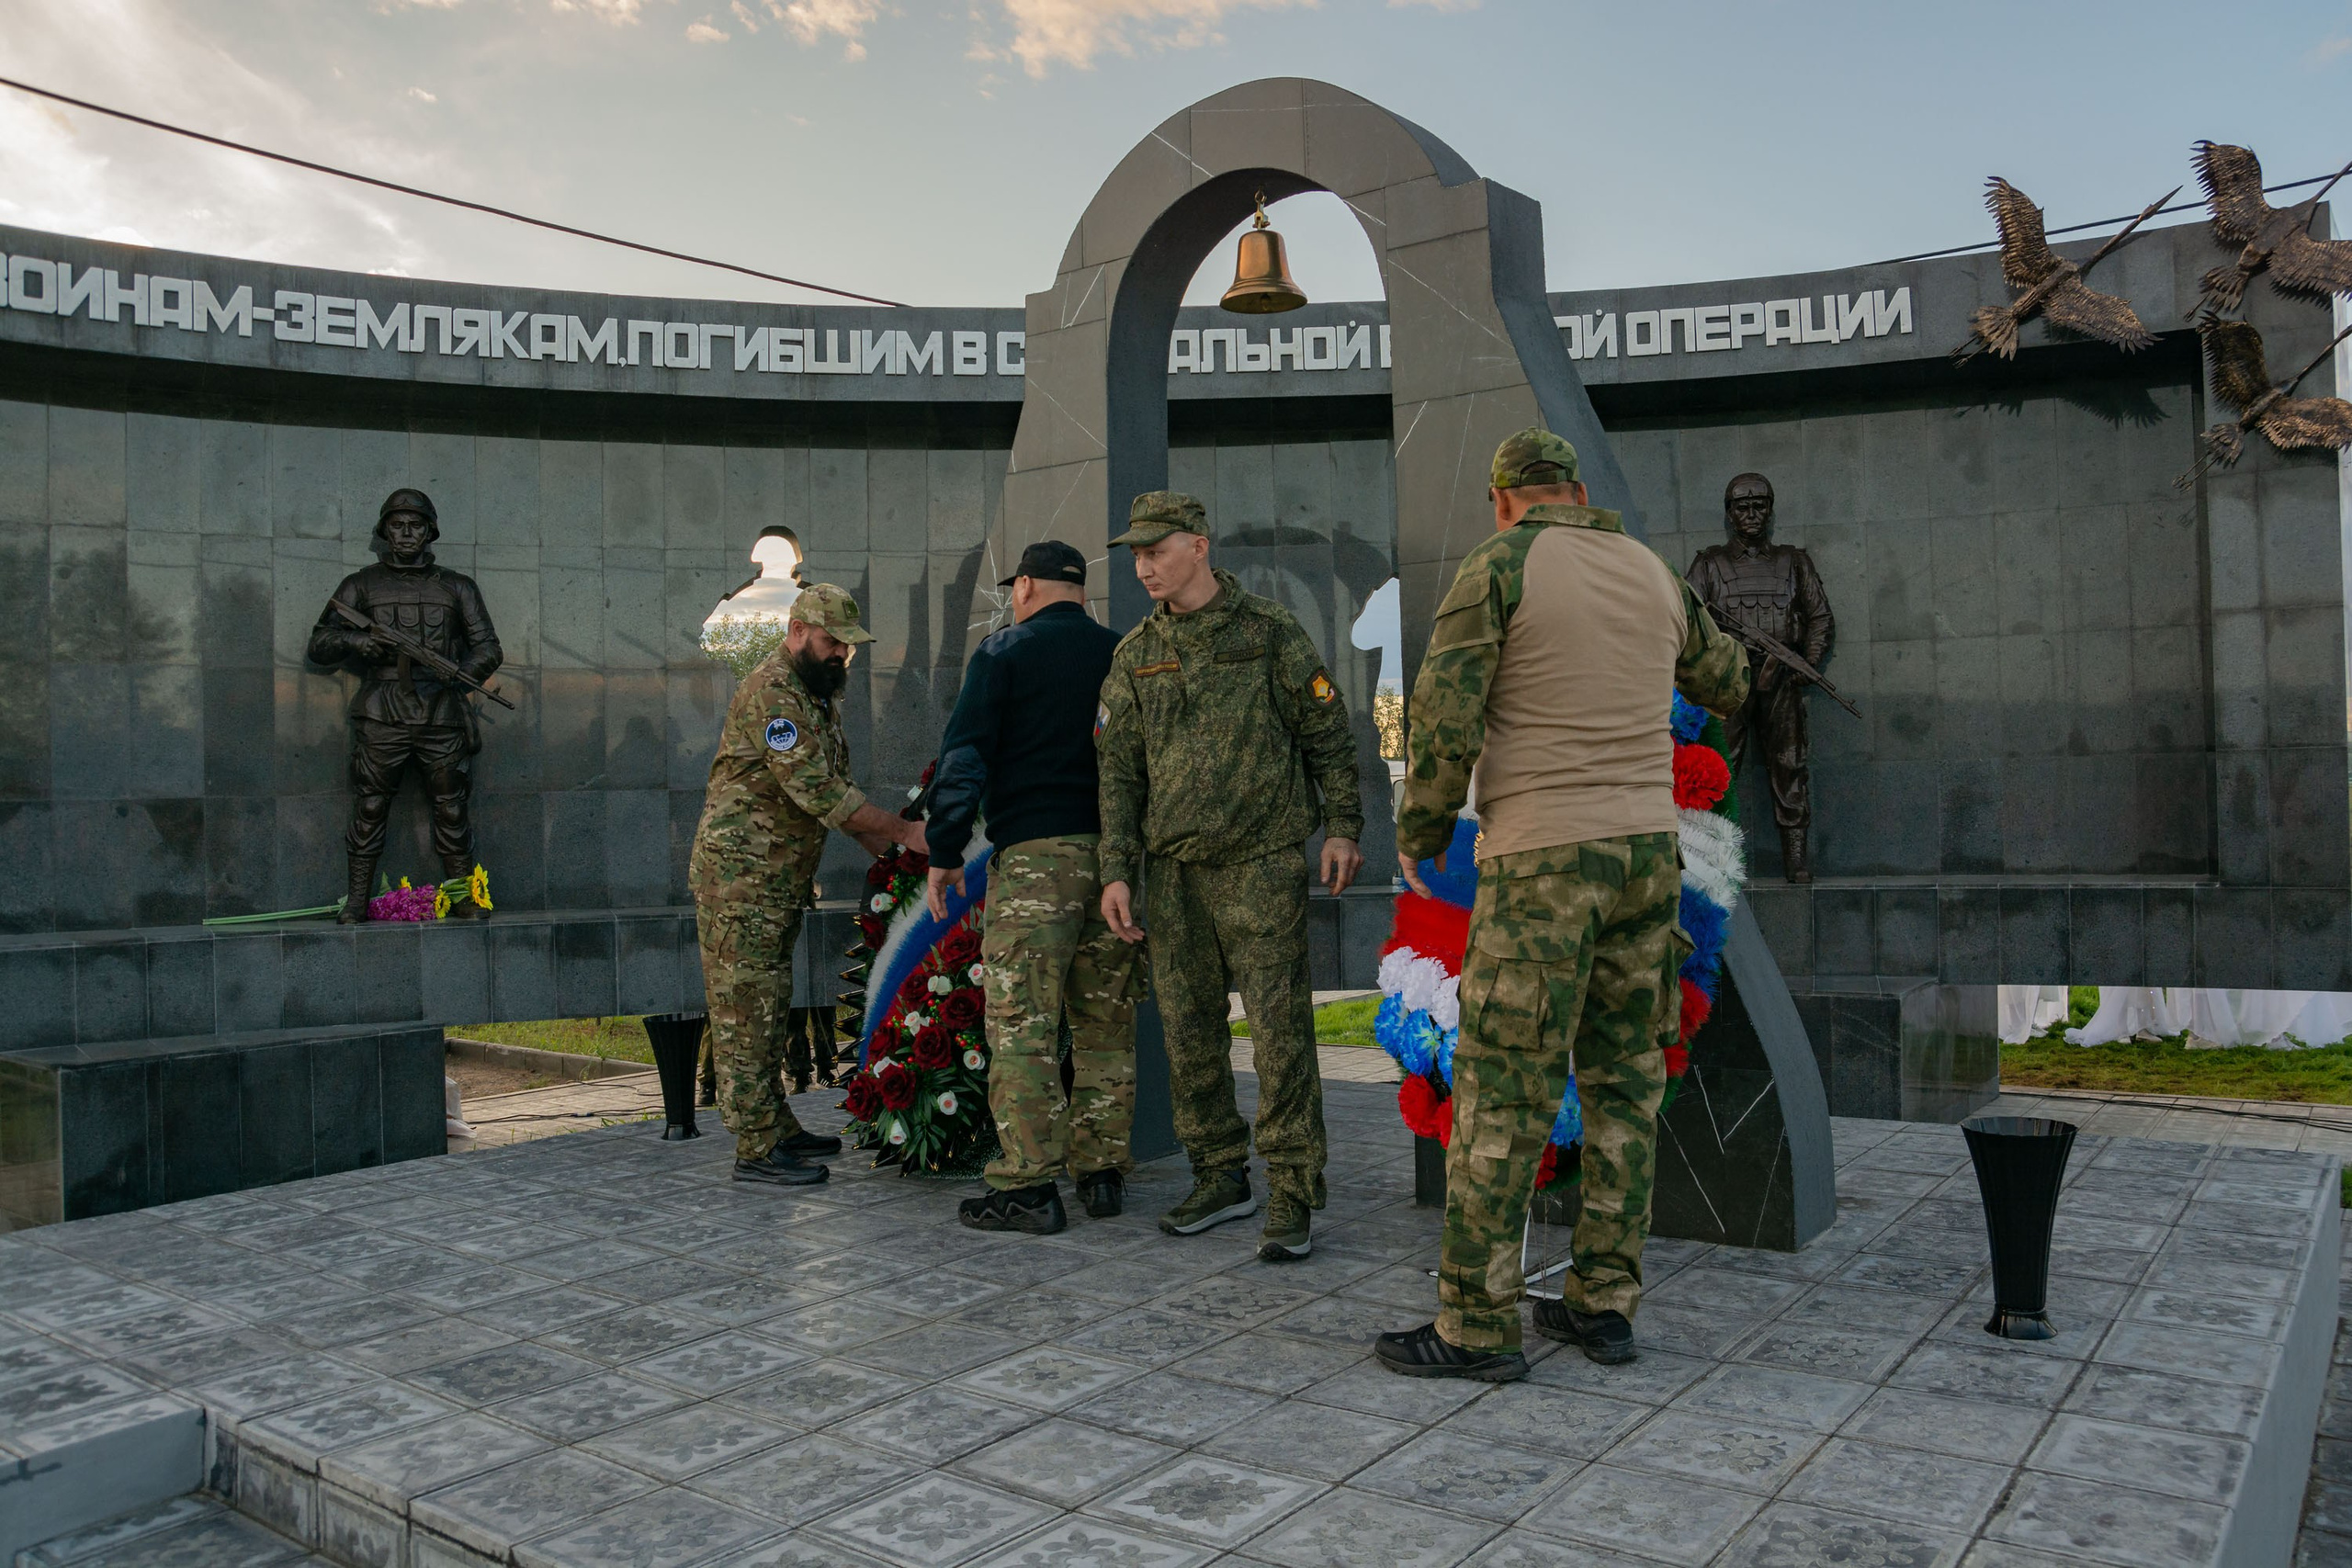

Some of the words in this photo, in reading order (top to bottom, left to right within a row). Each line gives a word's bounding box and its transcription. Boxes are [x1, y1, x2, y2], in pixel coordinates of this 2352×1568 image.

[0, 251, 627, 367] ОИНАМ-ЗЕМЛЯКАМ,
[628, 320, 944, 376] ПОГИБШИМ
[953, 331, 987, 376] В
[1625, 287, 1913, 357] ОПЕРАЦИИ
